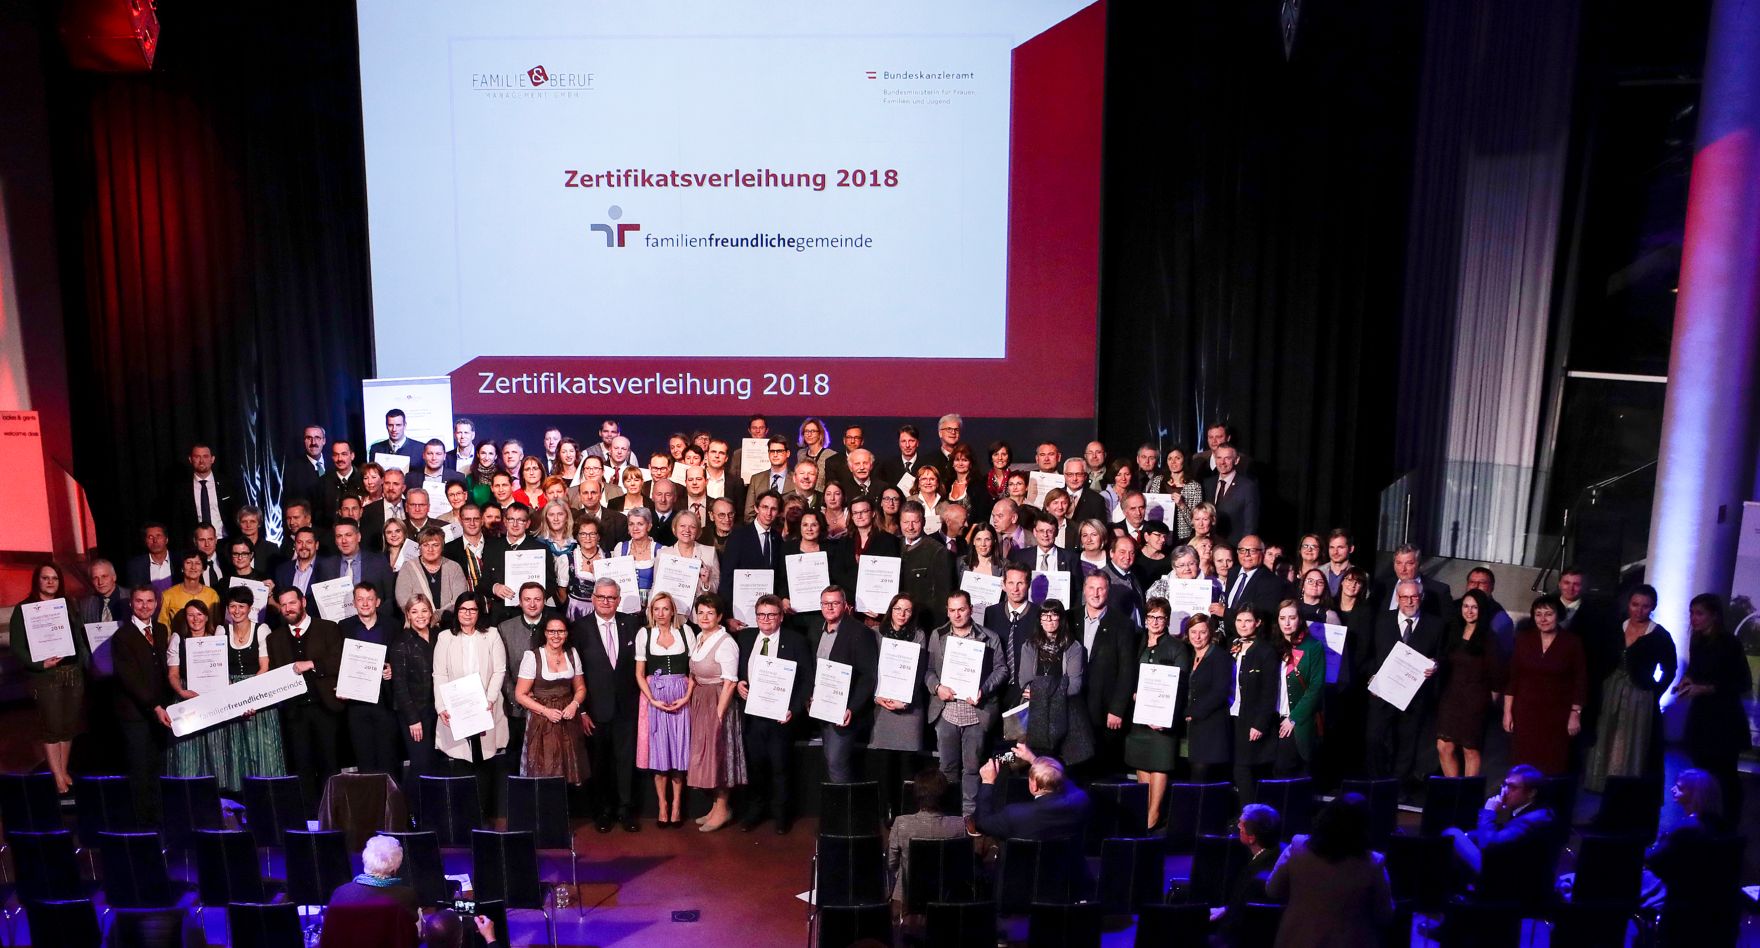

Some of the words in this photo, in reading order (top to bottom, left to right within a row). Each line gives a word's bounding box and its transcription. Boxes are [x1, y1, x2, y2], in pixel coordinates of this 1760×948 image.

[472, 73, 526, 88] FAMILIE
[550, 73, 595, 88] BERUF
[883, 71, 975, 80] Bundeskanzleramt
[883, 97, 911, 105] Familien
[564, 168, 826, 192] Zertifikatsverleihung
[836, 168, 899, 188] 2018
[644, 232, 873, 253] familienfreundlichegemeinde
[478, 371, 752, 401] Zertifikatsverleihung
[762, 373, 831, 396] 2018
[199, 678, 304, 721] familienfreundlichegemeinde
